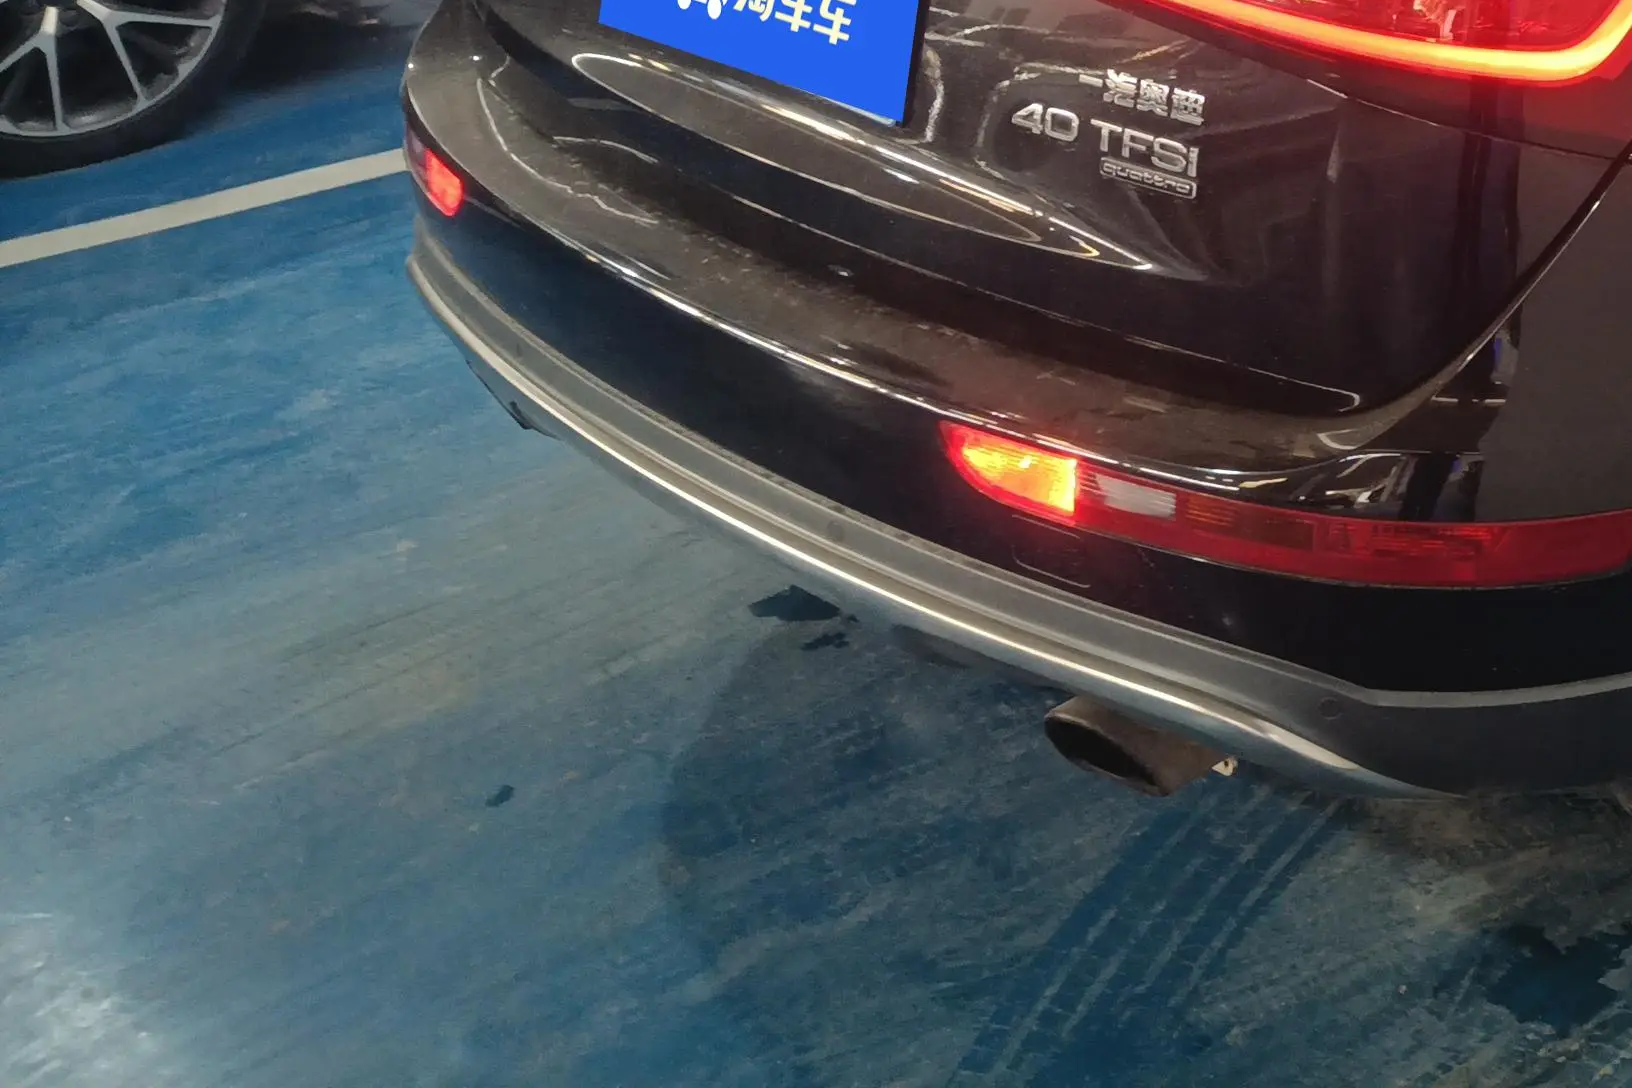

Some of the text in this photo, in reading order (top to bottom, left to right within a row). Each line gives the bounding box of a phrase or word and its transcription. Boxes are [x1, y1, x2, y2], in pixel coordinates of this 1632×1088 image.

[1078, 68, 1206, 126] 一汽奥迪
[1011, 102, 1080, 143] 40
[1101, 161, 1192, 195] quattro
